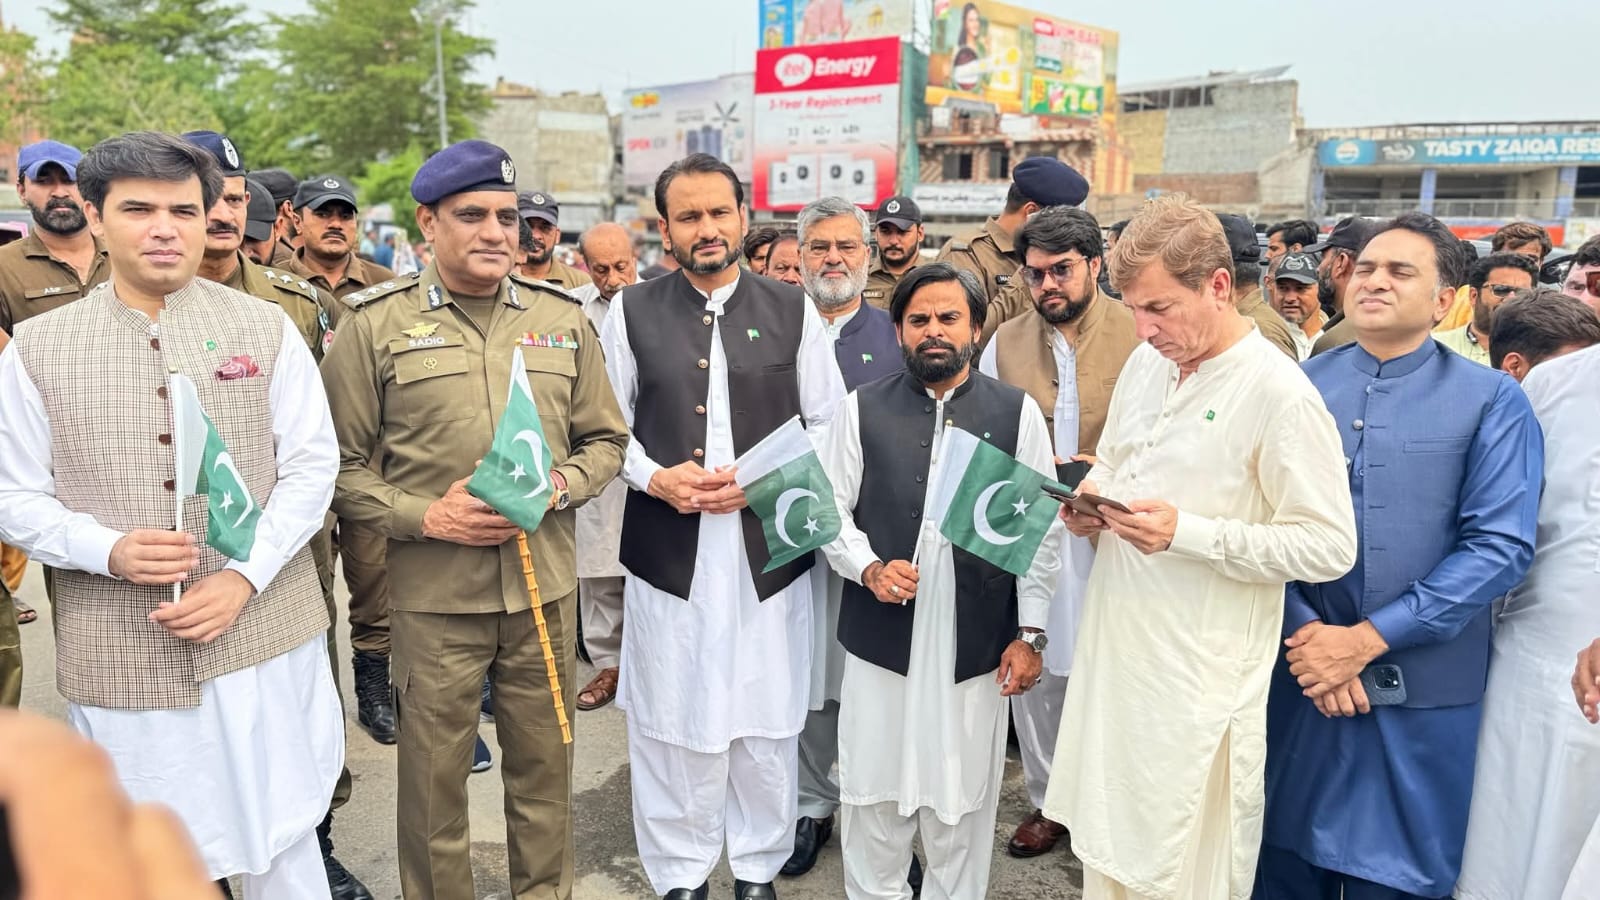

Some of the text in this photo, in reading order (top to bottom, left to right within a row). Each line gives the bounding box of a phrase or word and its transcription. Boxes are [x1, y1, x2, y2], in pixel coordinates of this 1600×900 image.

[814, 56, 877, 78] Energy
[806, 94, 882, 109] Replacement
[1423, 139, 1491, 157] TASTY
[1493, 138, 1558, 155] ZAIQA
